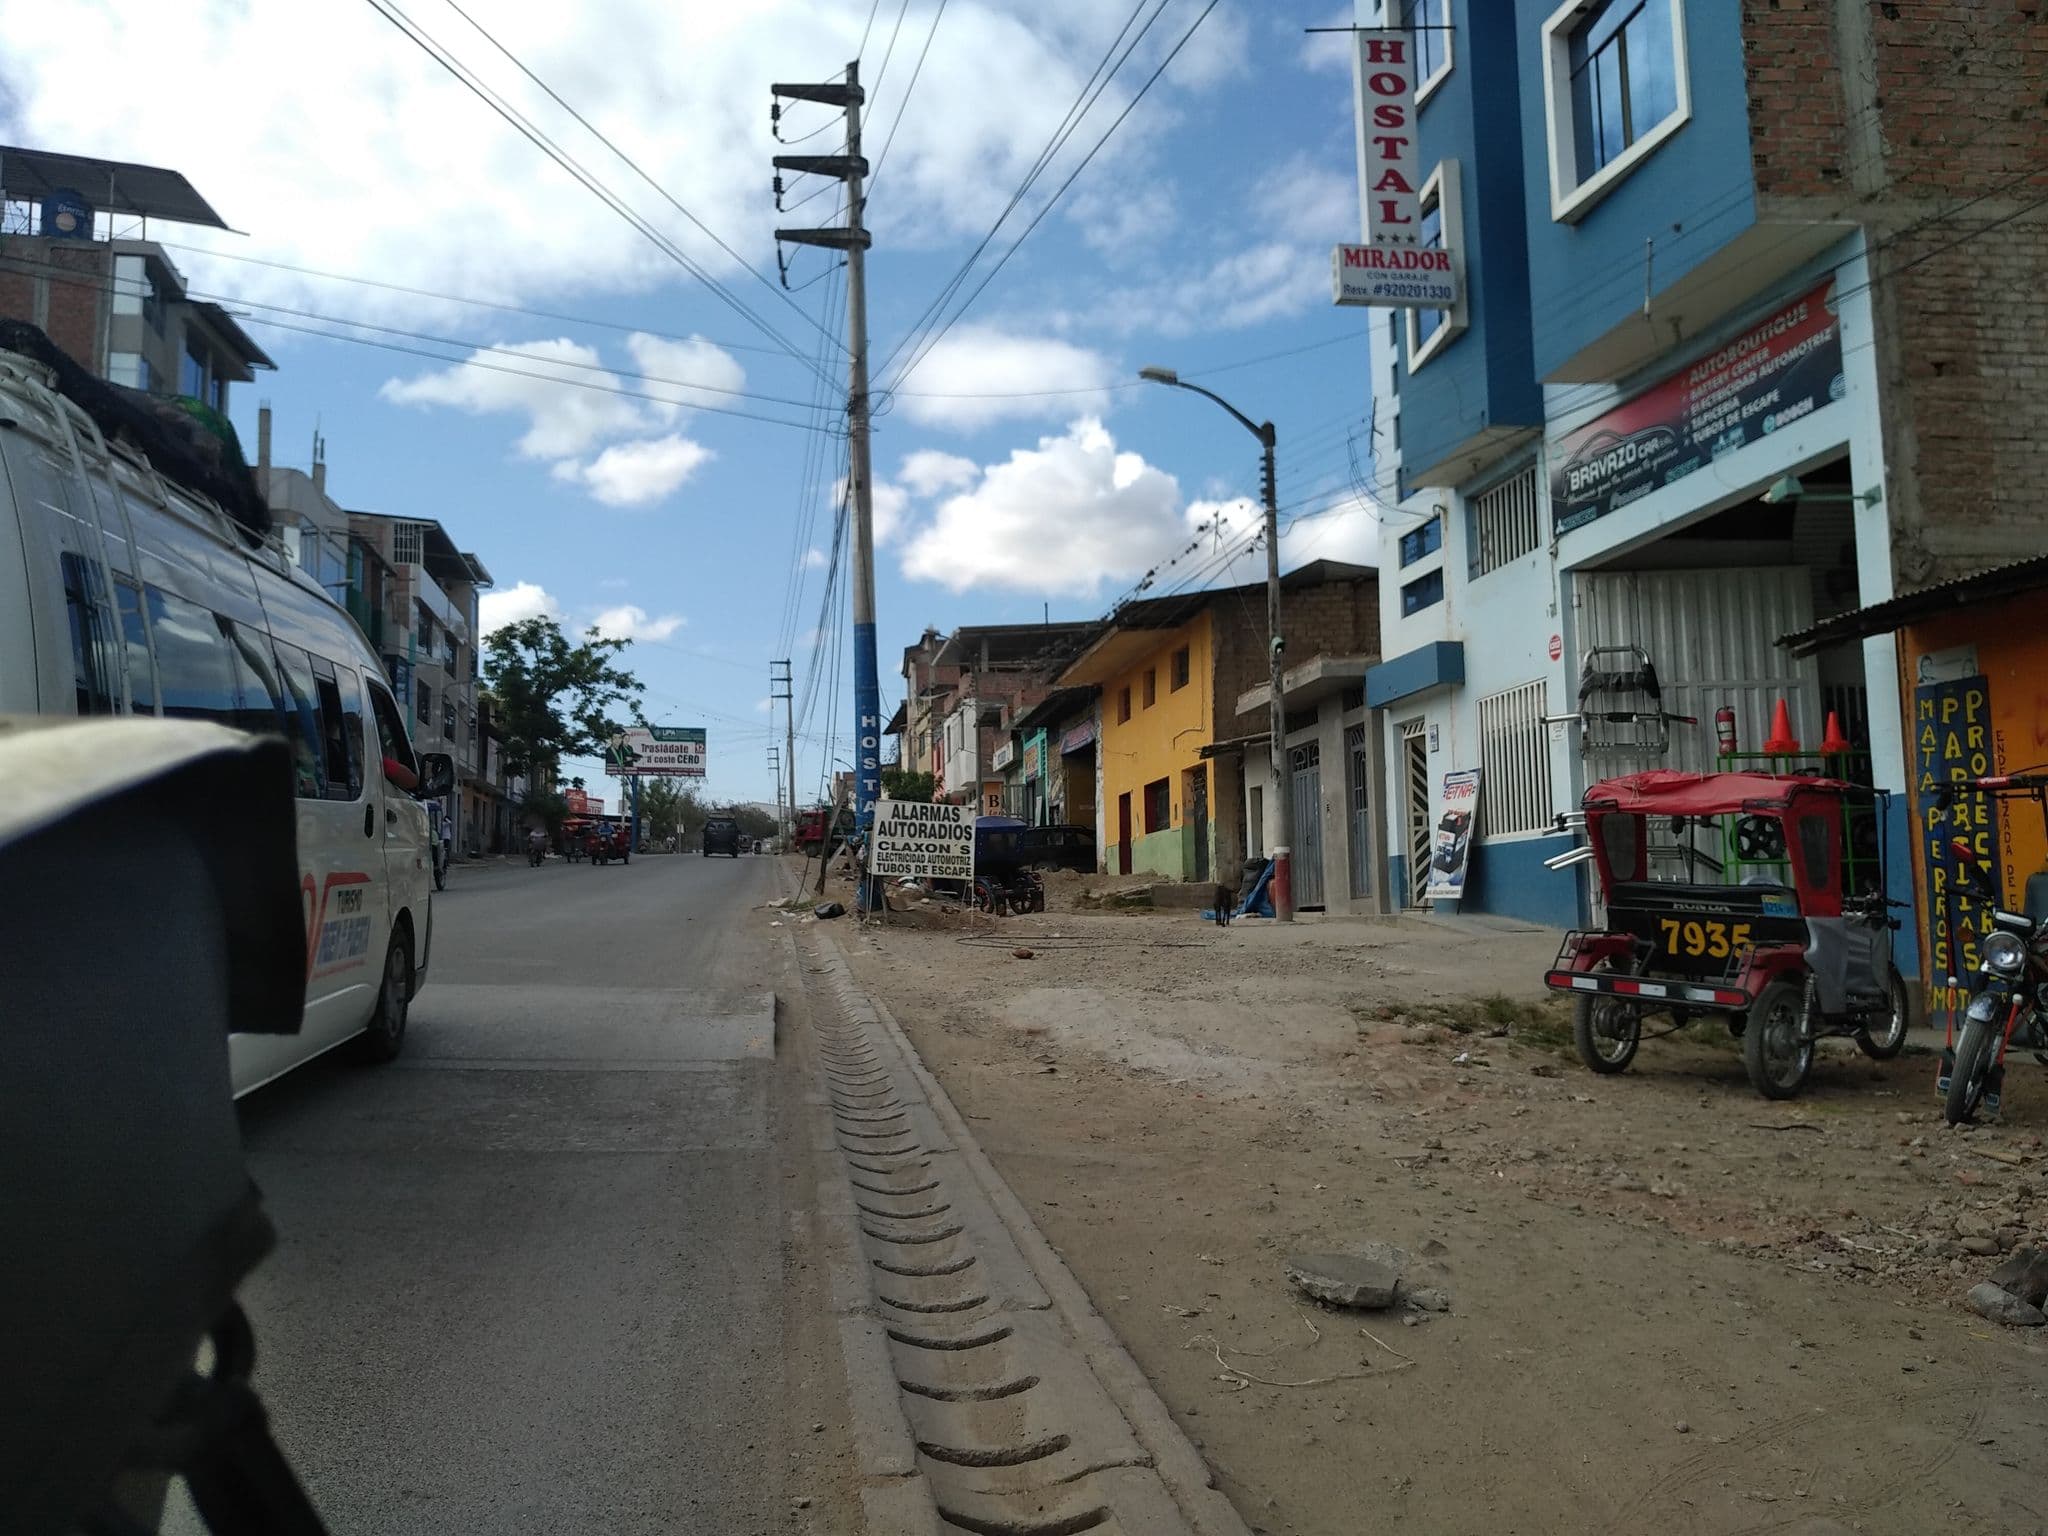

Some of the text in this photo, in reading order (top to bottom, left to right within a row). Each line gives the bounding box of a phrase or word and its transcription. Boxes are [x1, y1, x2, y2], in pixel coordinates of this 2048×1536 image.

[1366, 40, 1414, 224] HOSTAL
[1344, 248, 1451, 272] MIRADOR
[1366, 271, 1431, 282] CON GARAJE
[1689, 302, 1808, 385] AUTOBOUTIQUE
[1690, 328, 1833, 417] ELECTRICIDAD AUTOMOTRIZ
[1726, 411, 1741, 427] DE
[1741, 388, 1781, 418] ESCAPE
[1570, 442, 1636, 491] BRAVAZO
[641, 743, 689, 754] Trasládate
[1920, 699, 1937, 793] MATA
[654, 754, 676, 764] coste
[677, 754, 700, 765] CERO
[1445, 783, 1474, 801] ETNA
[891, 804, 961, 823] ALARMAS
[878, 820, 973, 841] AUTORADIOS
[876, 863, 972, 877] TUBOS DE ESCAPE
[877, 852, 971, 866] ELECTRICIDAD AUTOMOTRIZ
[1660, 918, 1755, 959] 7935
